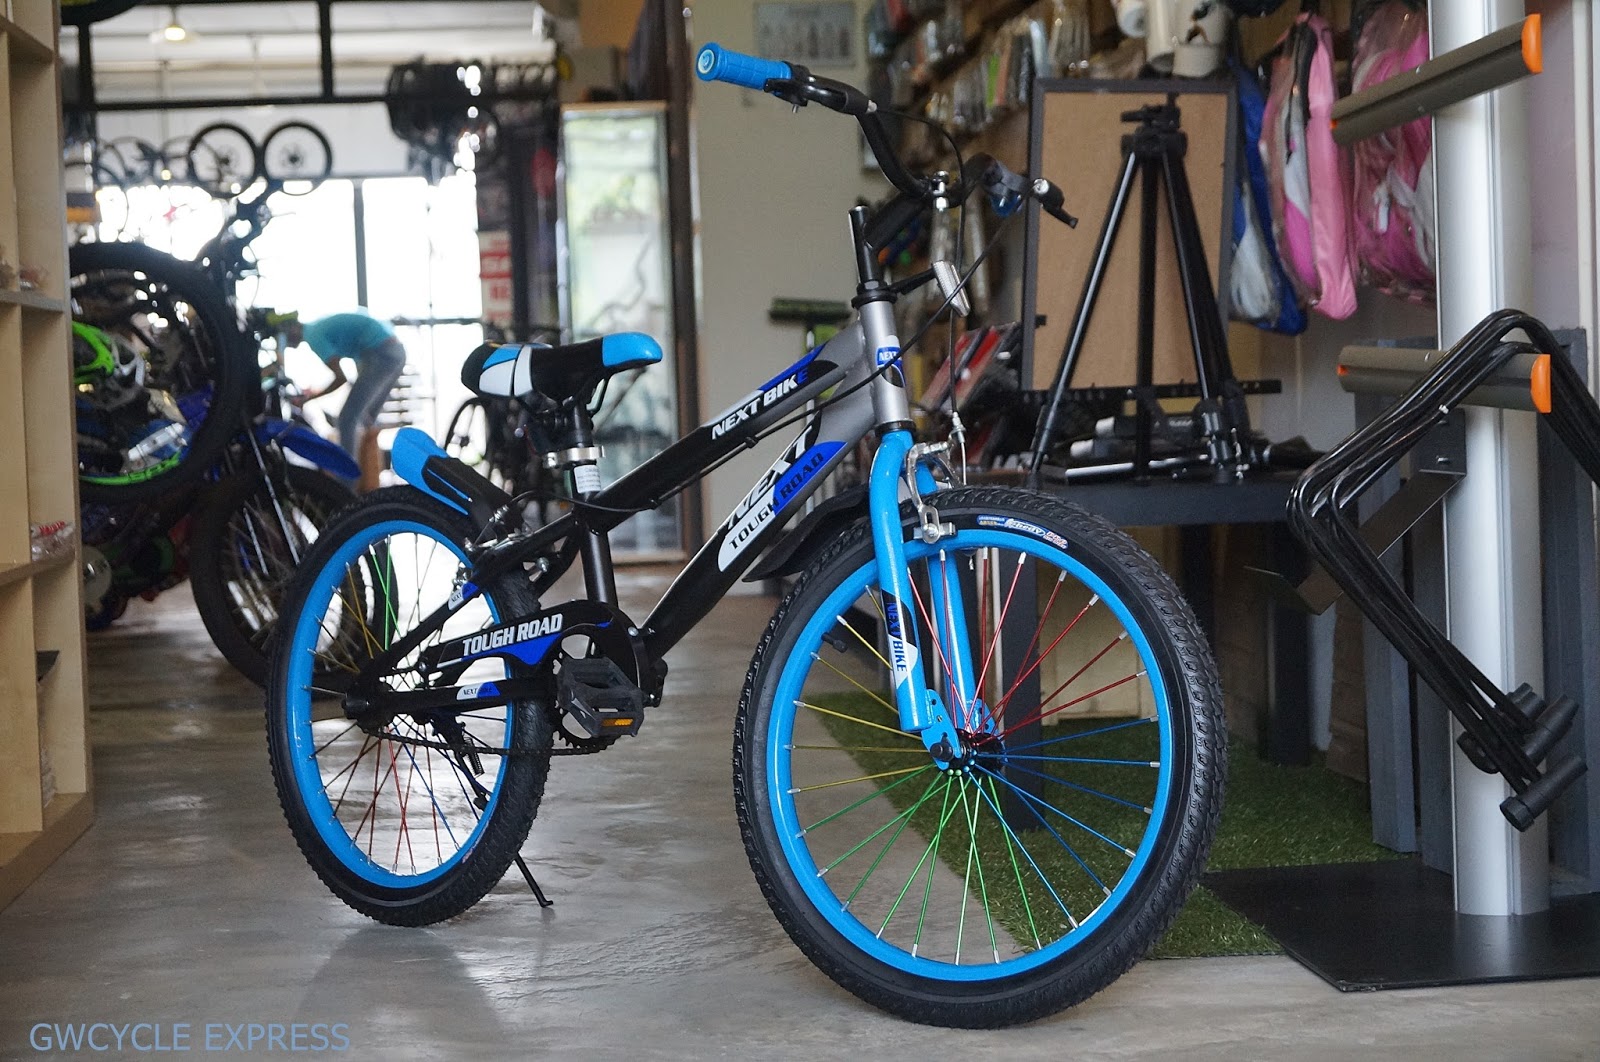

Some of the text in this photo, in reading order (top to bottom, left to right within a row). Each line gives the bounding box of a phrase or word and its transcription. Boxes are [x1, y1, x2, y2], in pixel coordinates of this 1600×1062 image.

[712, 367, 808, 440] NEXT BIKE
[727, 425, 813, 530] NEXT
[729, 452, 824, 550] TOUGH ROAD
[462, 613, 563, 657] TOUGH ROAD
[886, 602, 908, 672] NEXT BIKE
